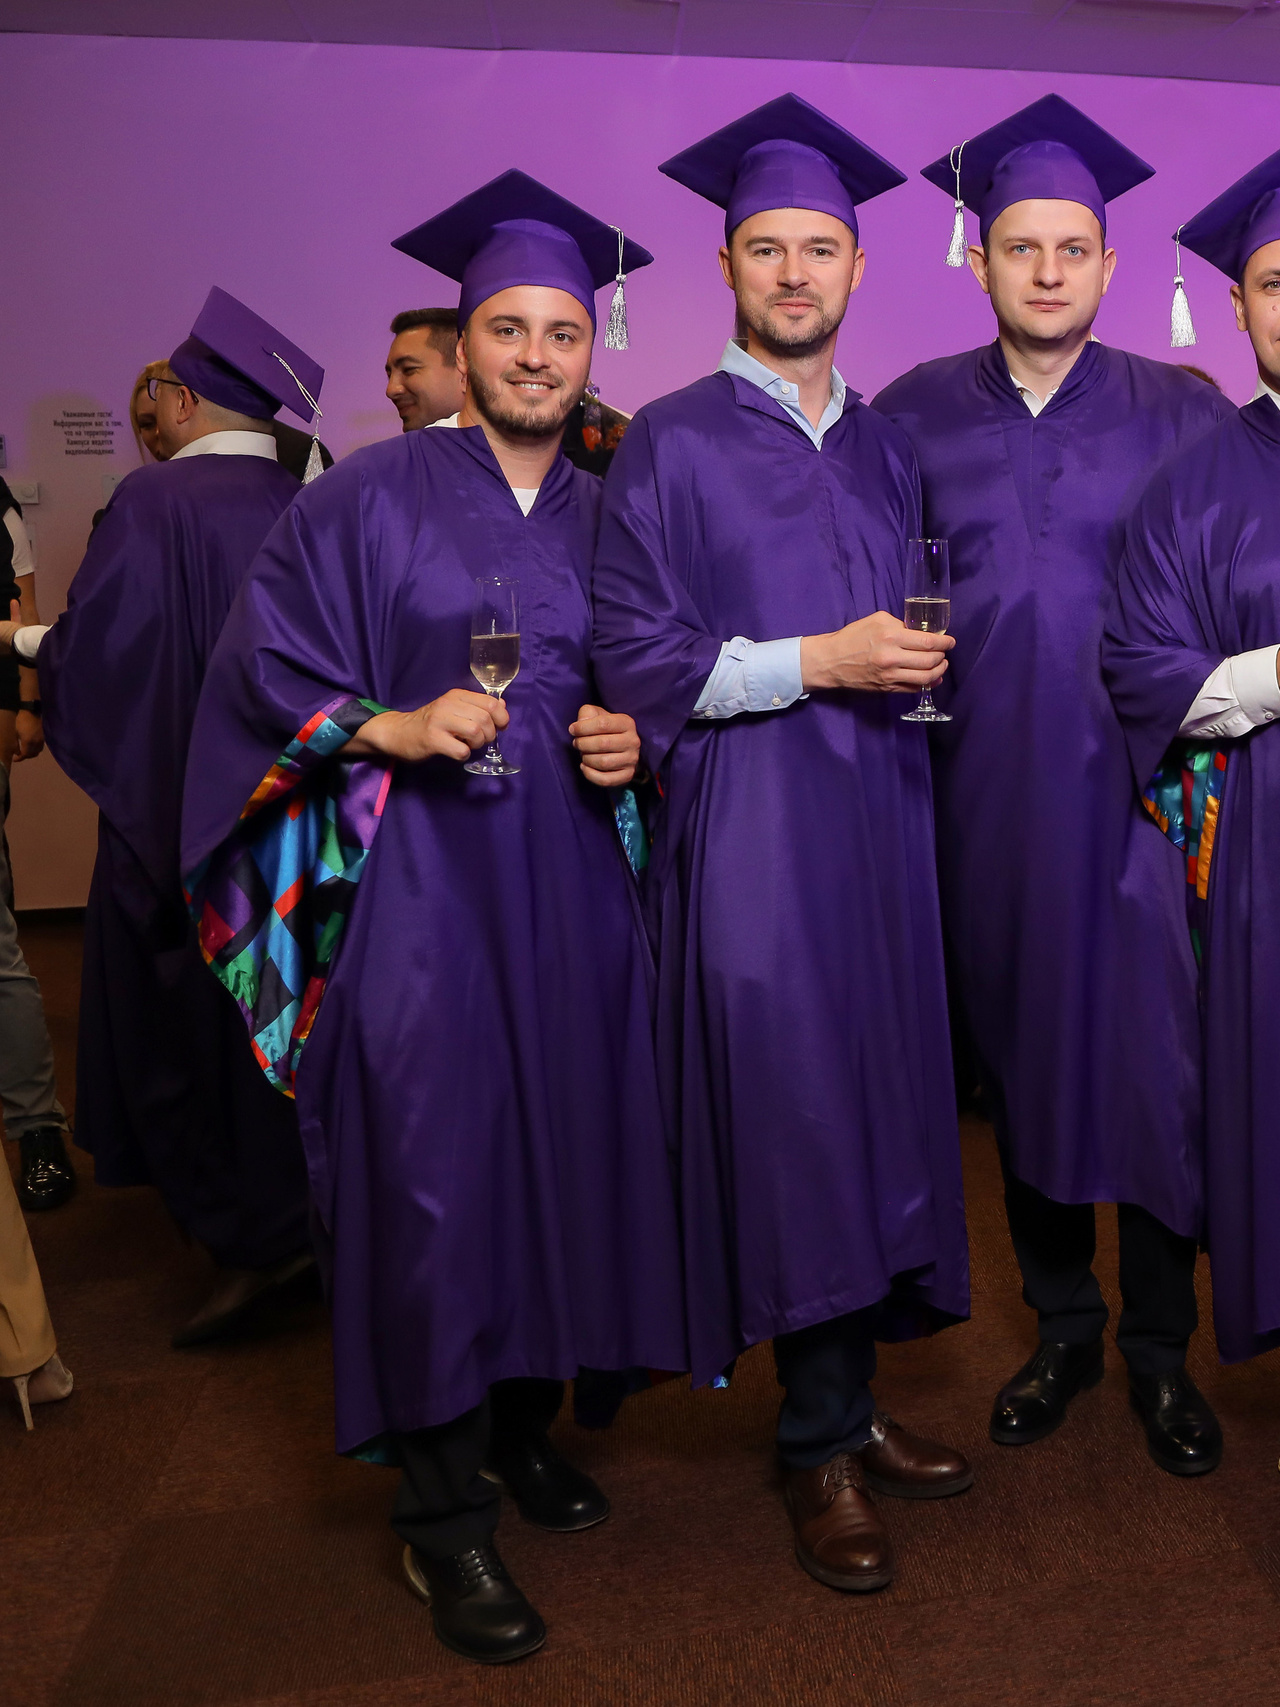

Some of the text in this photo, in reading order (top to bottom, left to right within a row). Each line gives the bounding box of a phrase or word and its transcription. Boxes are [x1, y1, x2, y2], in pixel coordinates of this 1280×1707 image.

[53, 420, 93, 428] Информируем
[84, 430, 114, 438] территории
[66, 438, 90, 447] Кампуса
